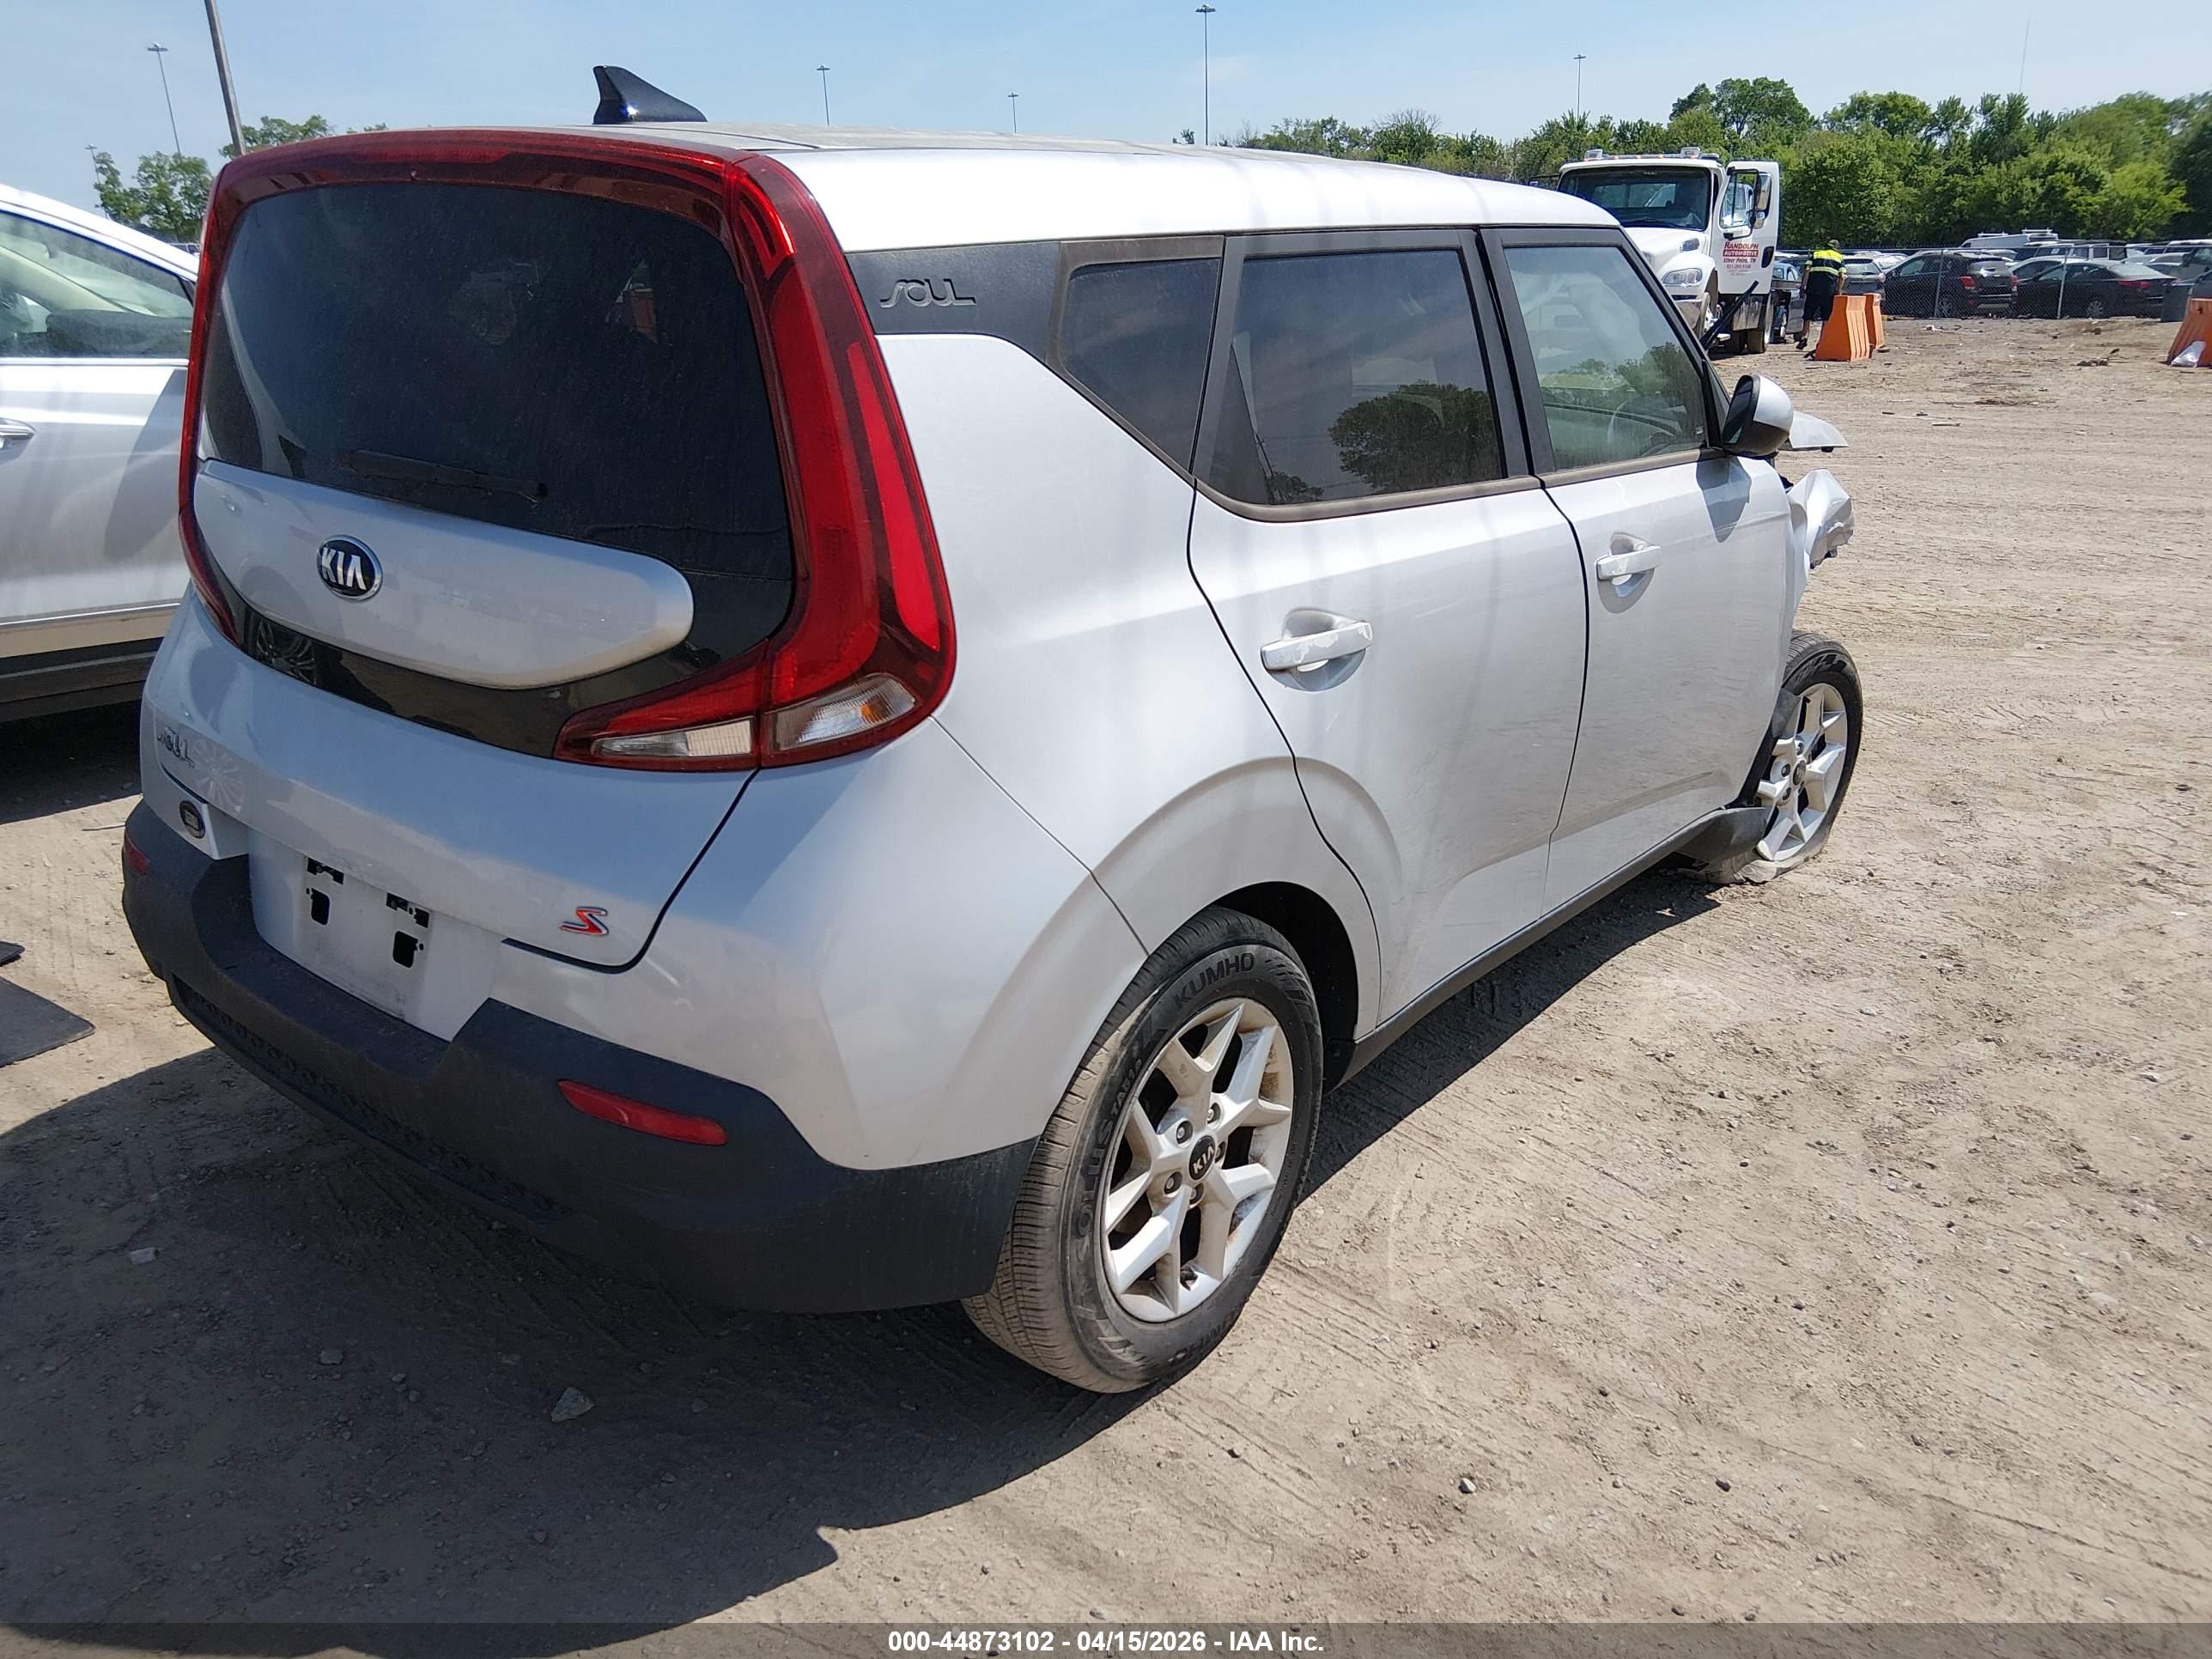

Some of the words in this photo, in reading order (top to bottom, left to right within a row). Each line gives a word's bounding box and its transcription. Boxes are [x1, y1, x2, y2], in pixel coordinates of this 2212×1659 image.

[879, 278, 976, 308] SOUL
[321, 547, 368, 591] KIA
[560, 905, 610, 936] S
[1173, 952, 1255, 1012] KUMHO
[1193, 1145, 1215, 1176] KIA
